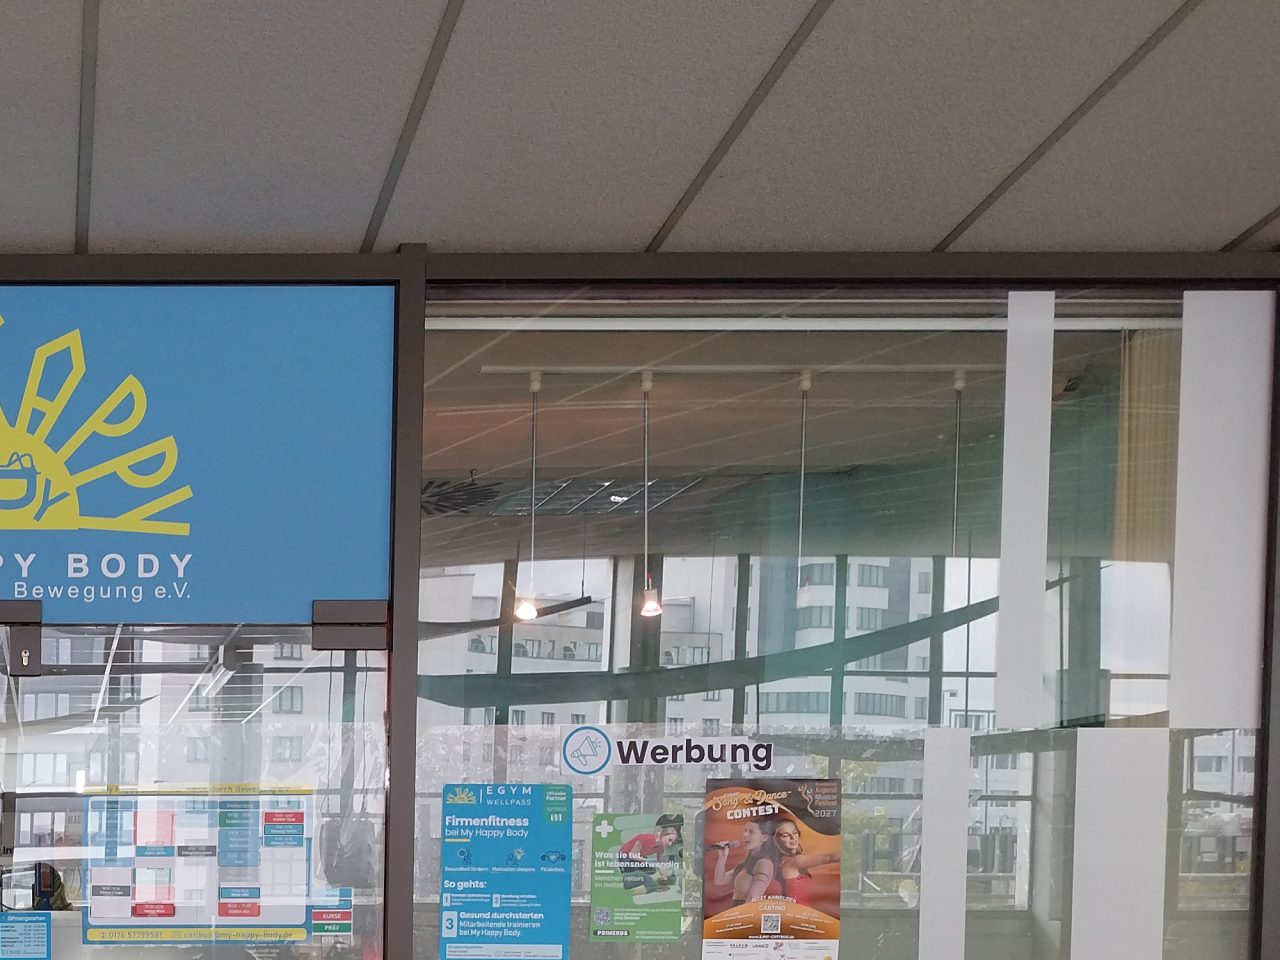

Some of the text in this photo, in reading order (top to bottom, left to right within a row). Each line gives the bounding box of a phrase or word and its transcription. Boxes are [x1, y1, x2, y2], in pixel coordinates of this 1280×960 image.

[67, 553, 192, 578] BODY
[15, 581, 143, 602] Bewegung
[154, 582, 191, 599] e.V.
[617, 739, 773, 771] Werbung
[486, 786, 532, 794] EGYM
[755, 789, 789, 805] Dance
[726, 804, 780, 820] CONTEST
[814, 809, 837, 818] 2027
[445, 815, 529, 826] Firmenfitness
[445, 828, 529, 838] bei My Happy Body
[595, 851, 614, 859] Was
[606, 860, 679, 869] lebensnotwendig
[443, 880, 487, 890] So gehts:
[459, 911, 544, 919] Gesund durchstarten
[446, 918, 453, 929] 3
[470, 929, 480, 937] My
[481, 929, 503, 938] Happy
